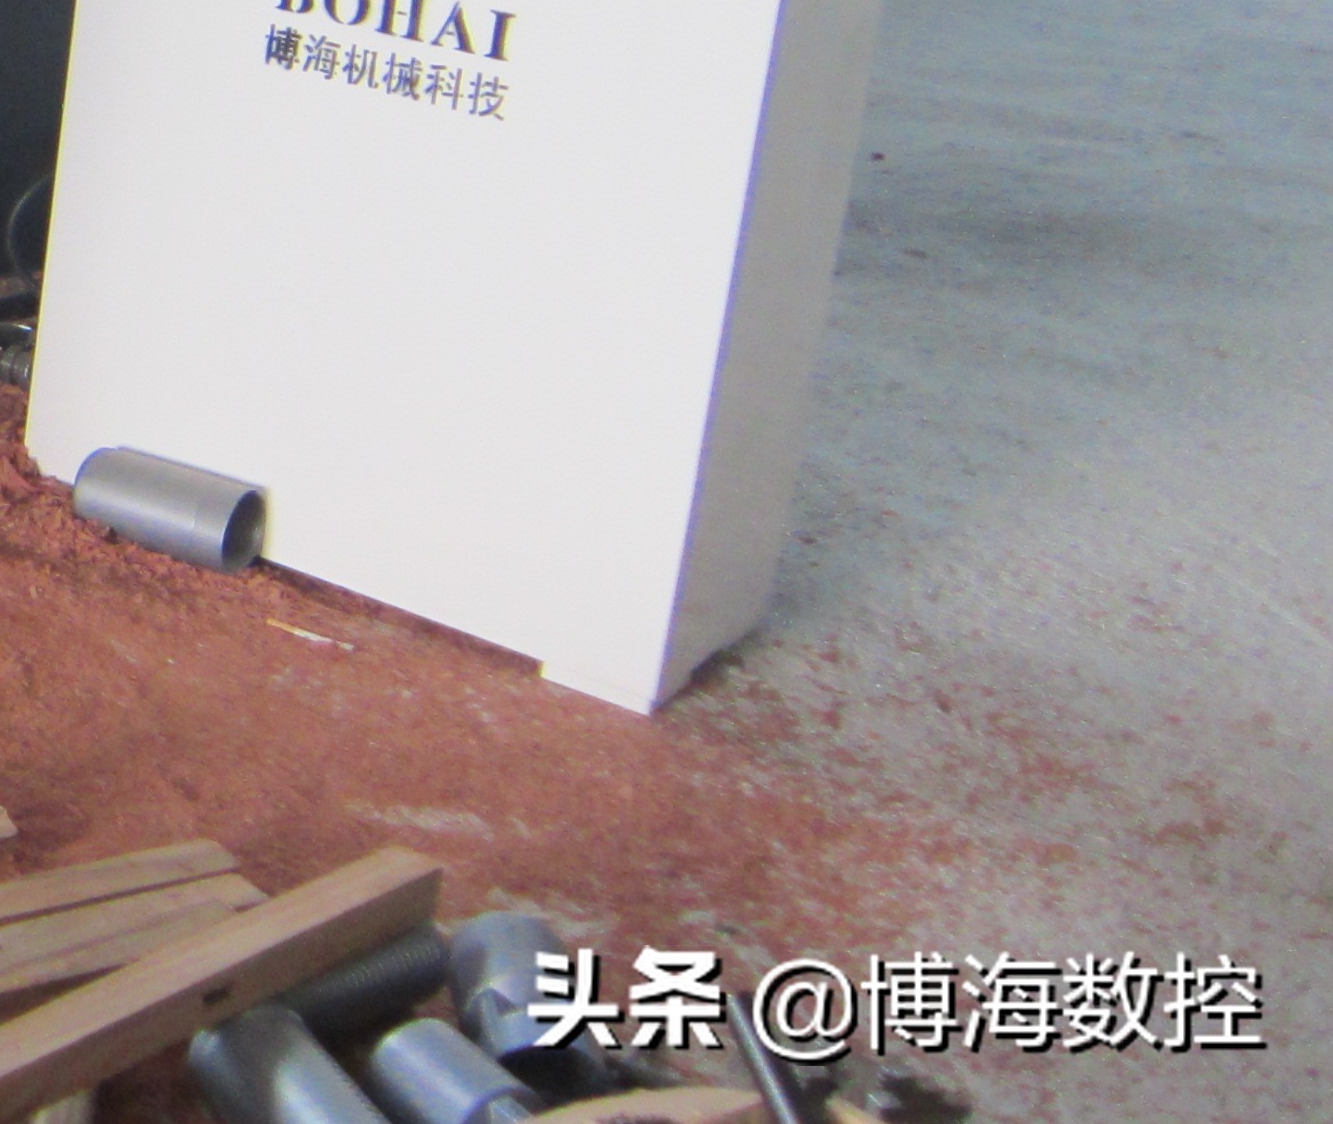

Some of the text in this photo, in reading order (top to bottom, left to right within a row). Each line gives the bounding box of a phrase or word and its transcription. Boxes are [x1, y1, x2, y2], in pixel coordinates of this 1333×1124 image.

[265, 23, 509, 121] 博海机械科技
